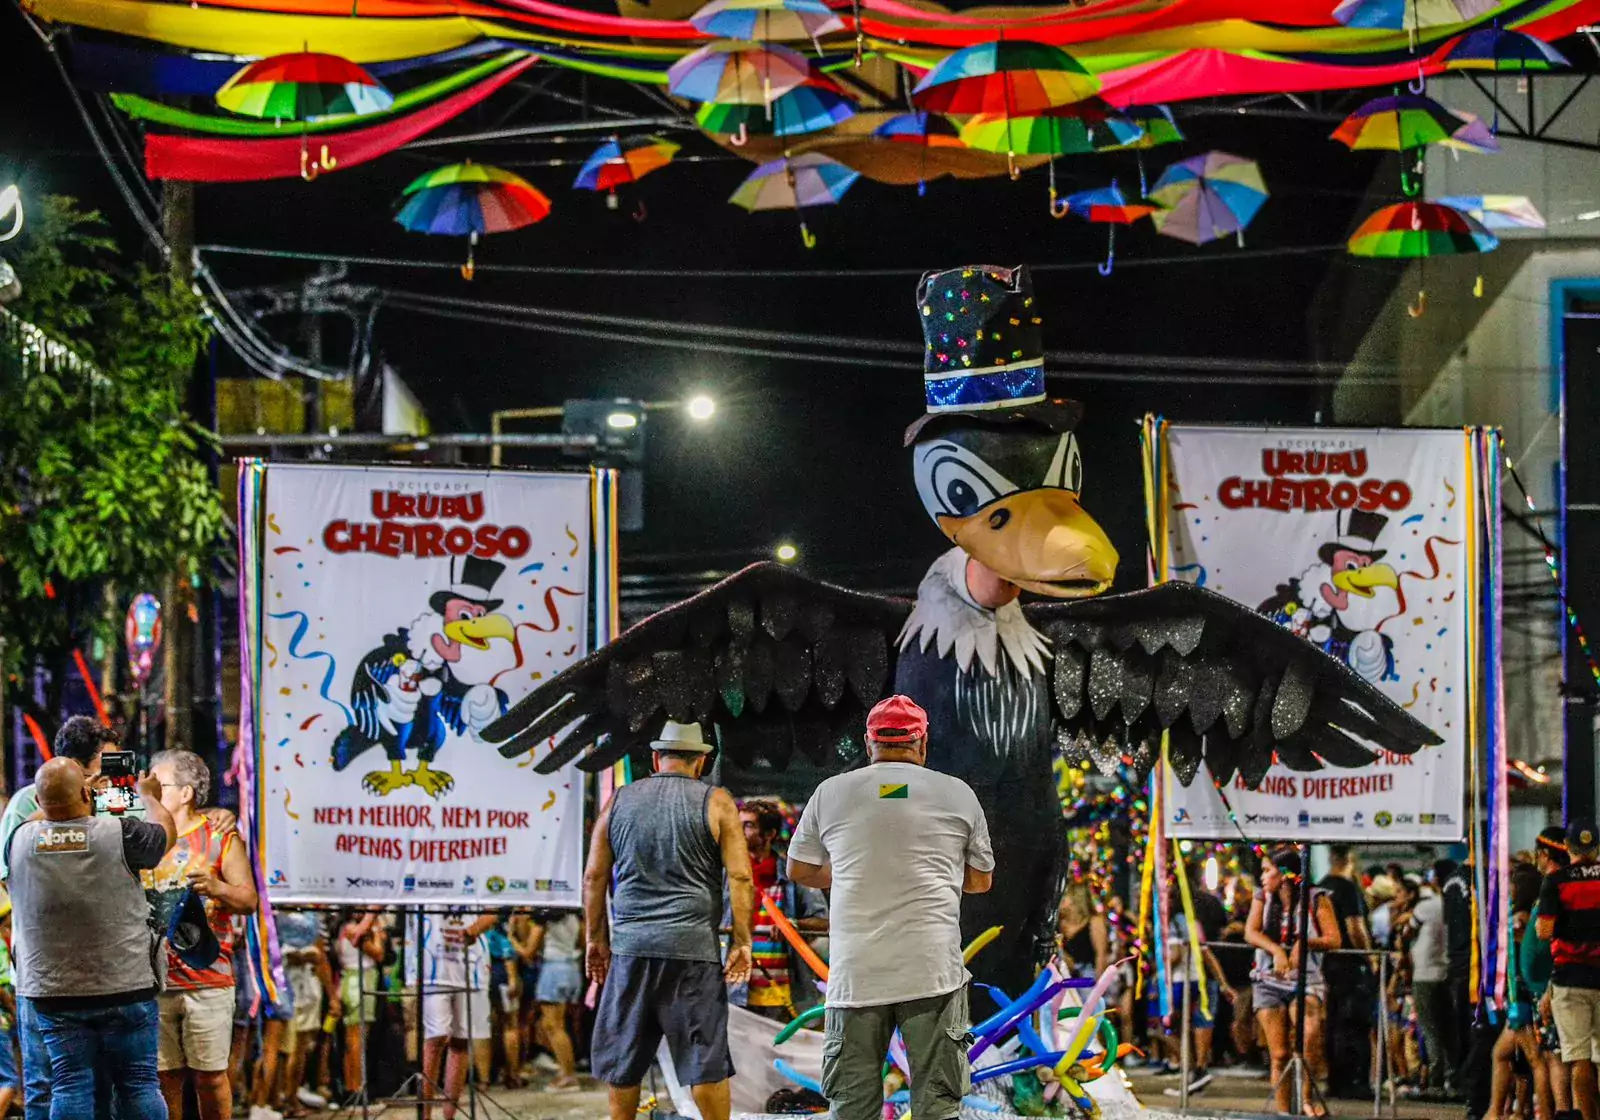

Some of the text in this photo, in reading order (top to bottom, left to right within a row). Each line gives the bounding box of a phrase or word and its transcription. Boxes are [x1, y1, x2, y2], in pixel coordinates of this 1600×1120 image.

[1261, 448, 1369, 478] URUBU
[388, 481, 471, 491] SOCIEDADE
[1217, 476, 1412, 514] CHEIROSO
[371, 490, 485, 523] URUBU
[322, 518, 532, 559] CHEIROSO
[1303, 774, 1394, 800] DIFERENTE!
[313, 804, 530, 832] NEM MELHOR, NEM PIOR
[1259, 814, 1290, 826] Hering
[335, 833, 508, 863] APENAS DIFERENTE!
[361, 876, 395, 889] Hering
